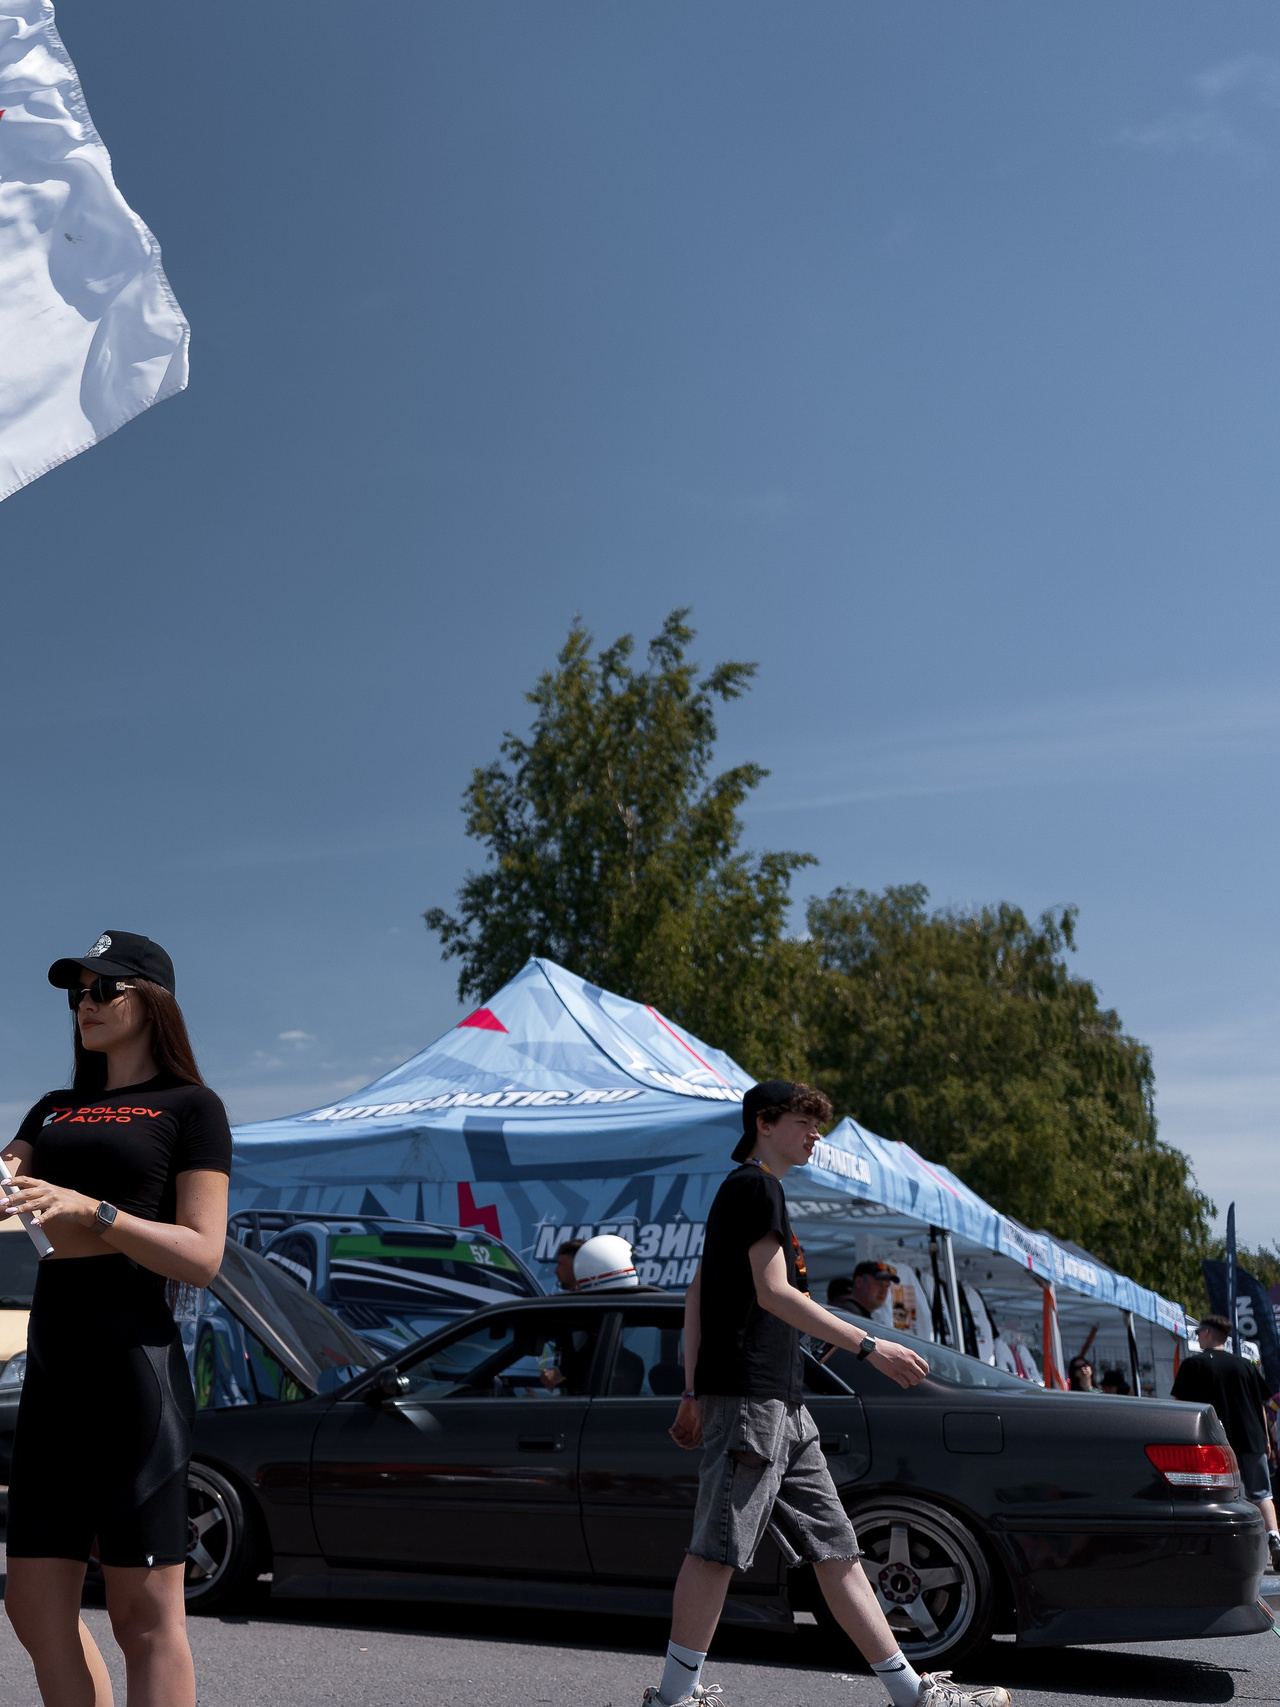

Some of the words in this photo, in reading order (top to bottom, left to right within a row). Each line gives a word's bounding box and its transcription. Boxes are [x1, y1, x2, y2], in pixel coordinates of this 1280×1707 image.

[76, 1106, 162, 1118] DOLGOV
[300, 1090, 646, 1122] AUTOFANATIC.RU
[69, 1115, 131, 1123] AUTO
[469, 1244, 494, 1266] 52
